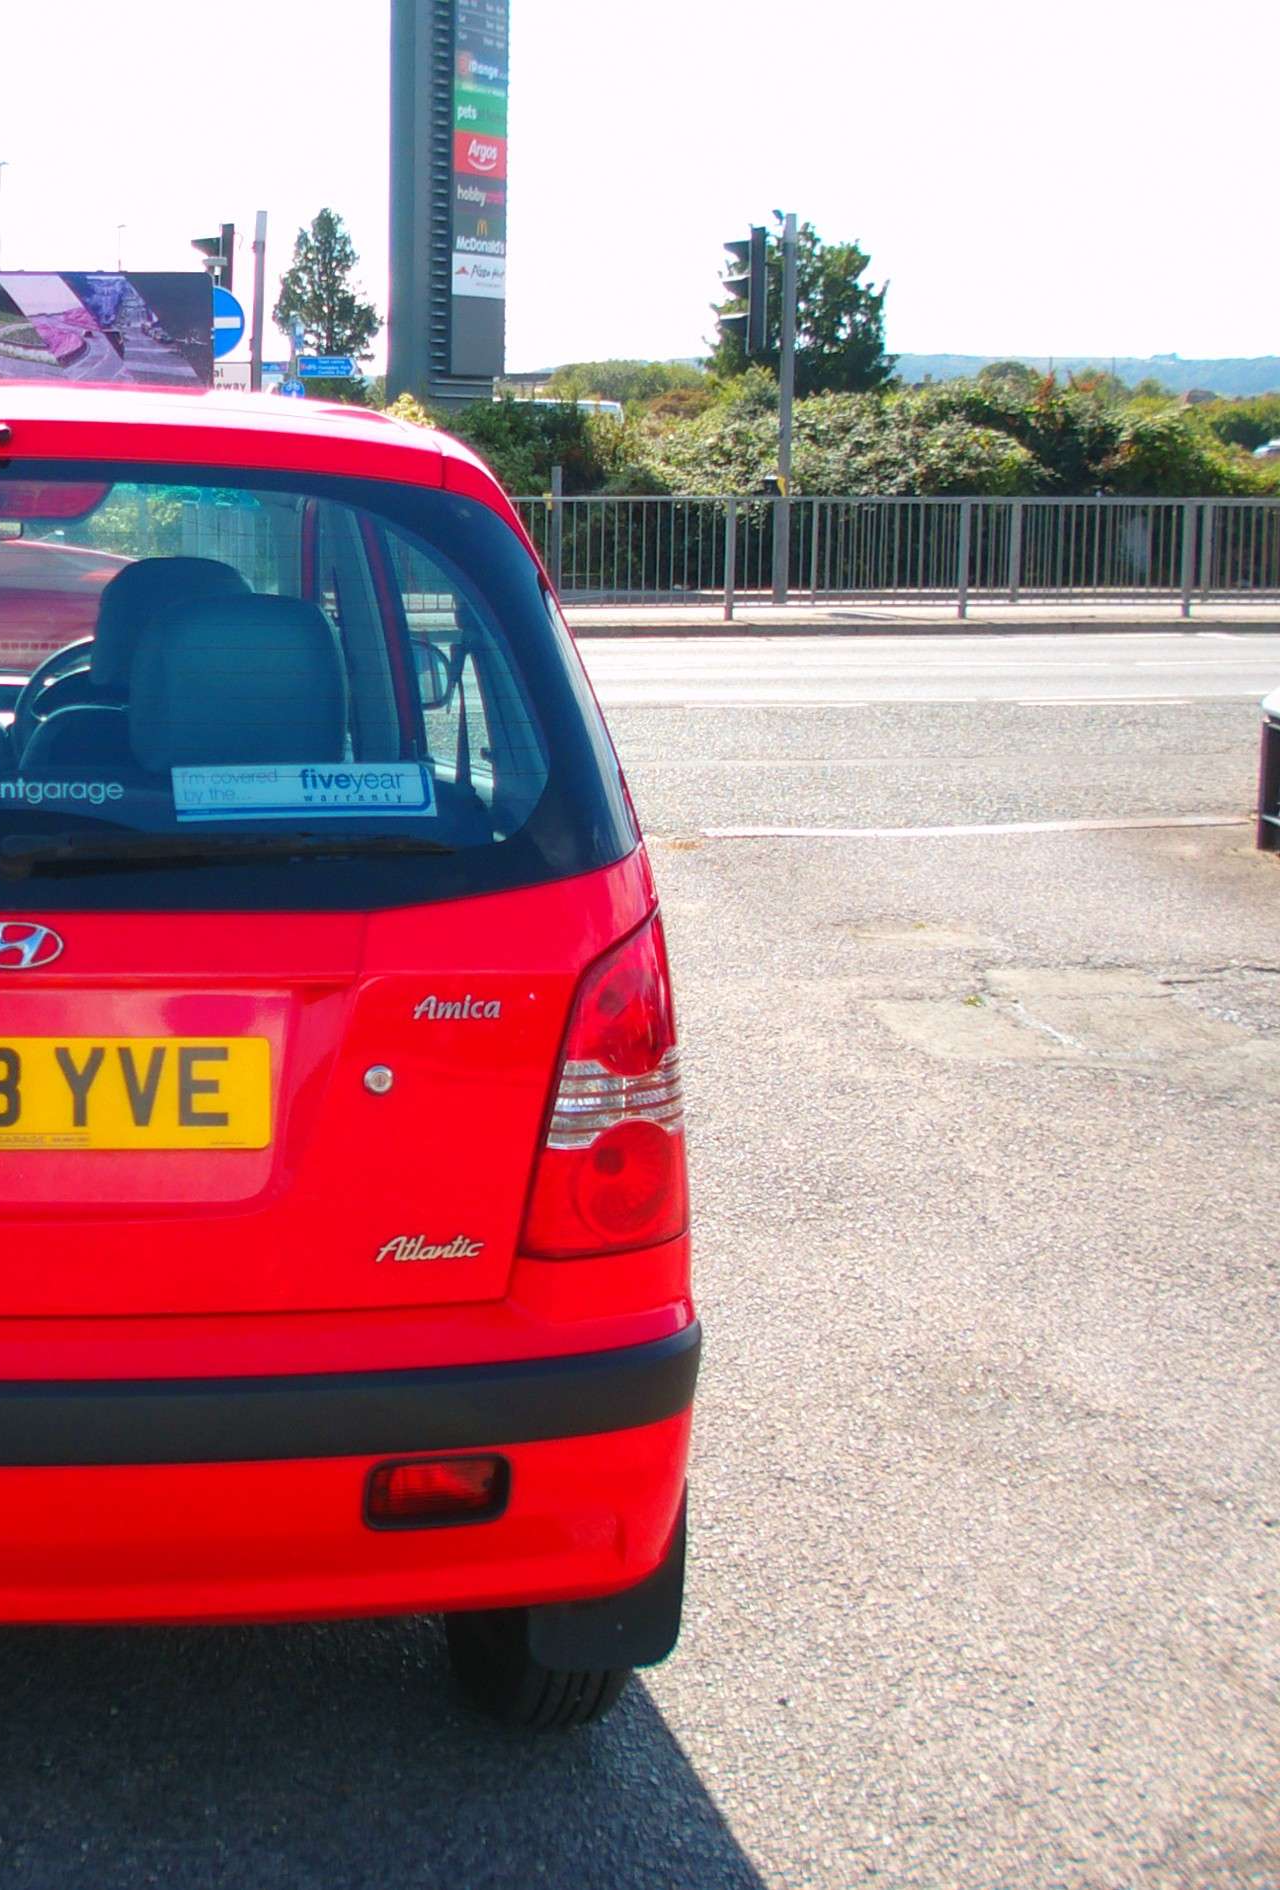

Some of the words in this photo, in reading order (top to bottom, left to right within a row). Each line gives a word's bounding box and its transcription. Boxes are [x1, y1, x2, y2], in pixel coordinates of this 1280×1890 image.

[468, 139, 498, 162] Argos
[210, 769, 278, 785] covered
[184, 788, 204, 804] by
[303, 793, 402, 804] warranty
[413, 995, 501, 1020] Amica
[54, 1046, 229, 1128] YVE
[376, 1235, 484, 1263] Atlantic
